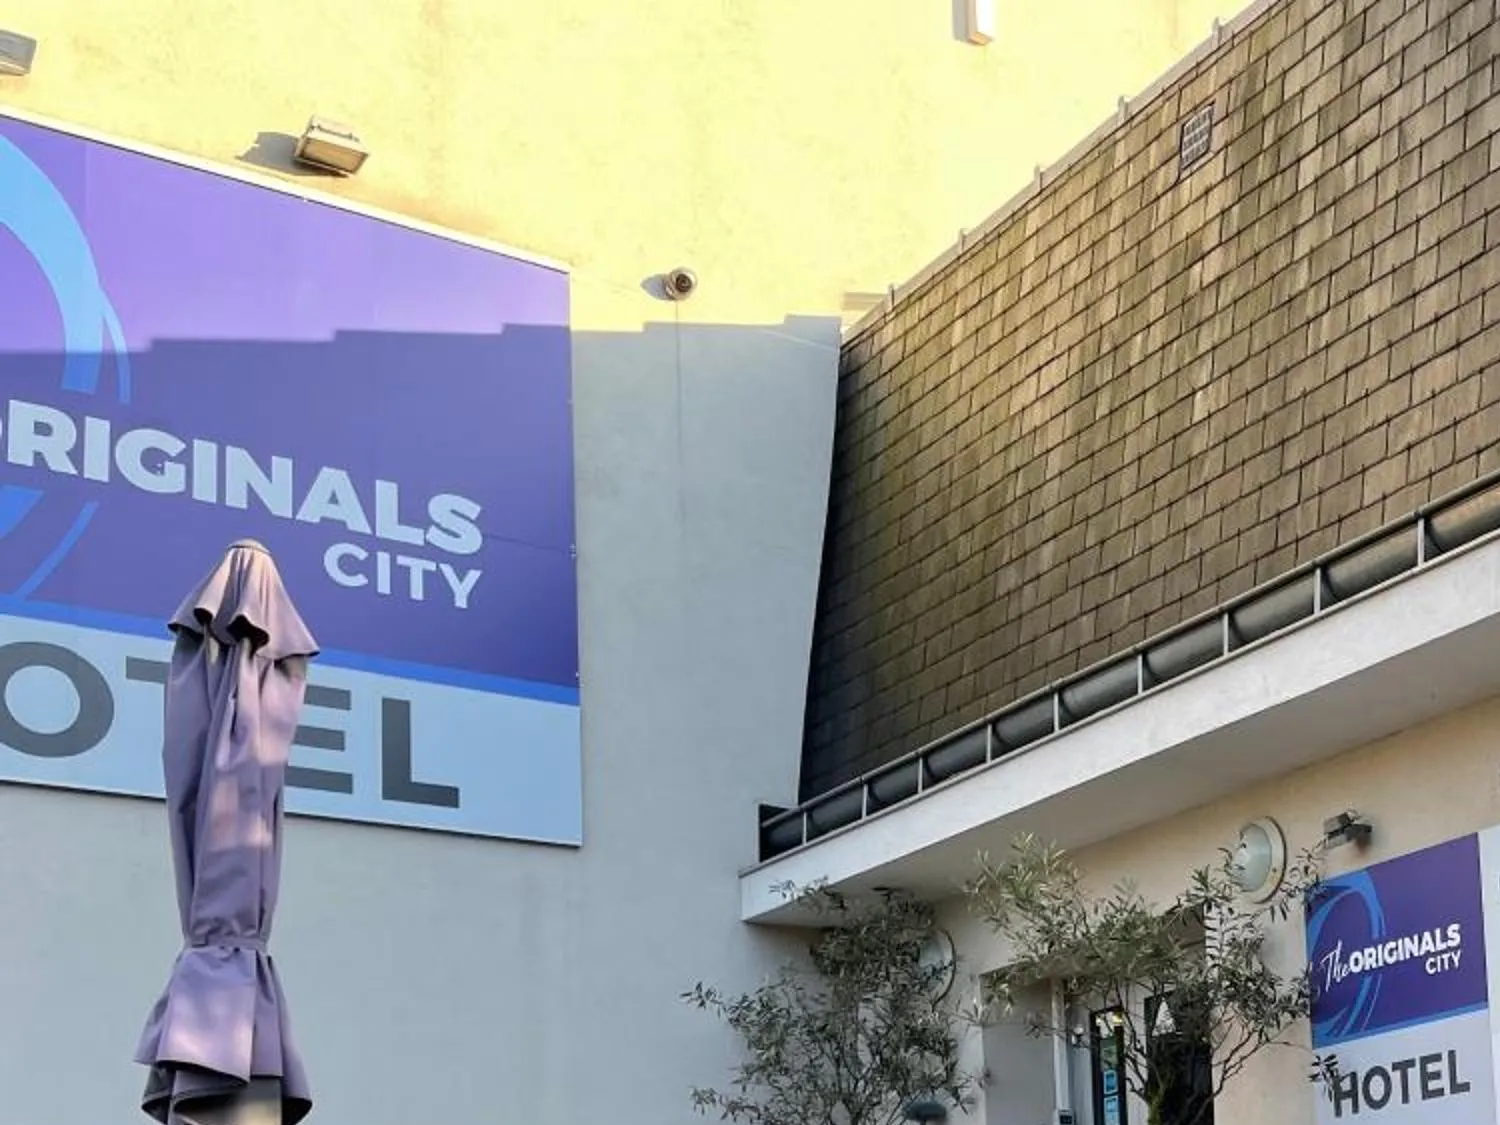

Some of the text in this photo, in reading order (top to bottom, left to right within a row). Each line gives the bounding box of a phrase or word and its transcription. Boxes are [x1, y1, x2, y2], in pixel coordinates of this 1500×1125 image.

[0, 399, 483, 555] RIGINALS
[322, 543, 483, 609] CITY
[1425, 950, 1462, 975] CITY
[1333, 1049, 1472, 1118] HOTEL
